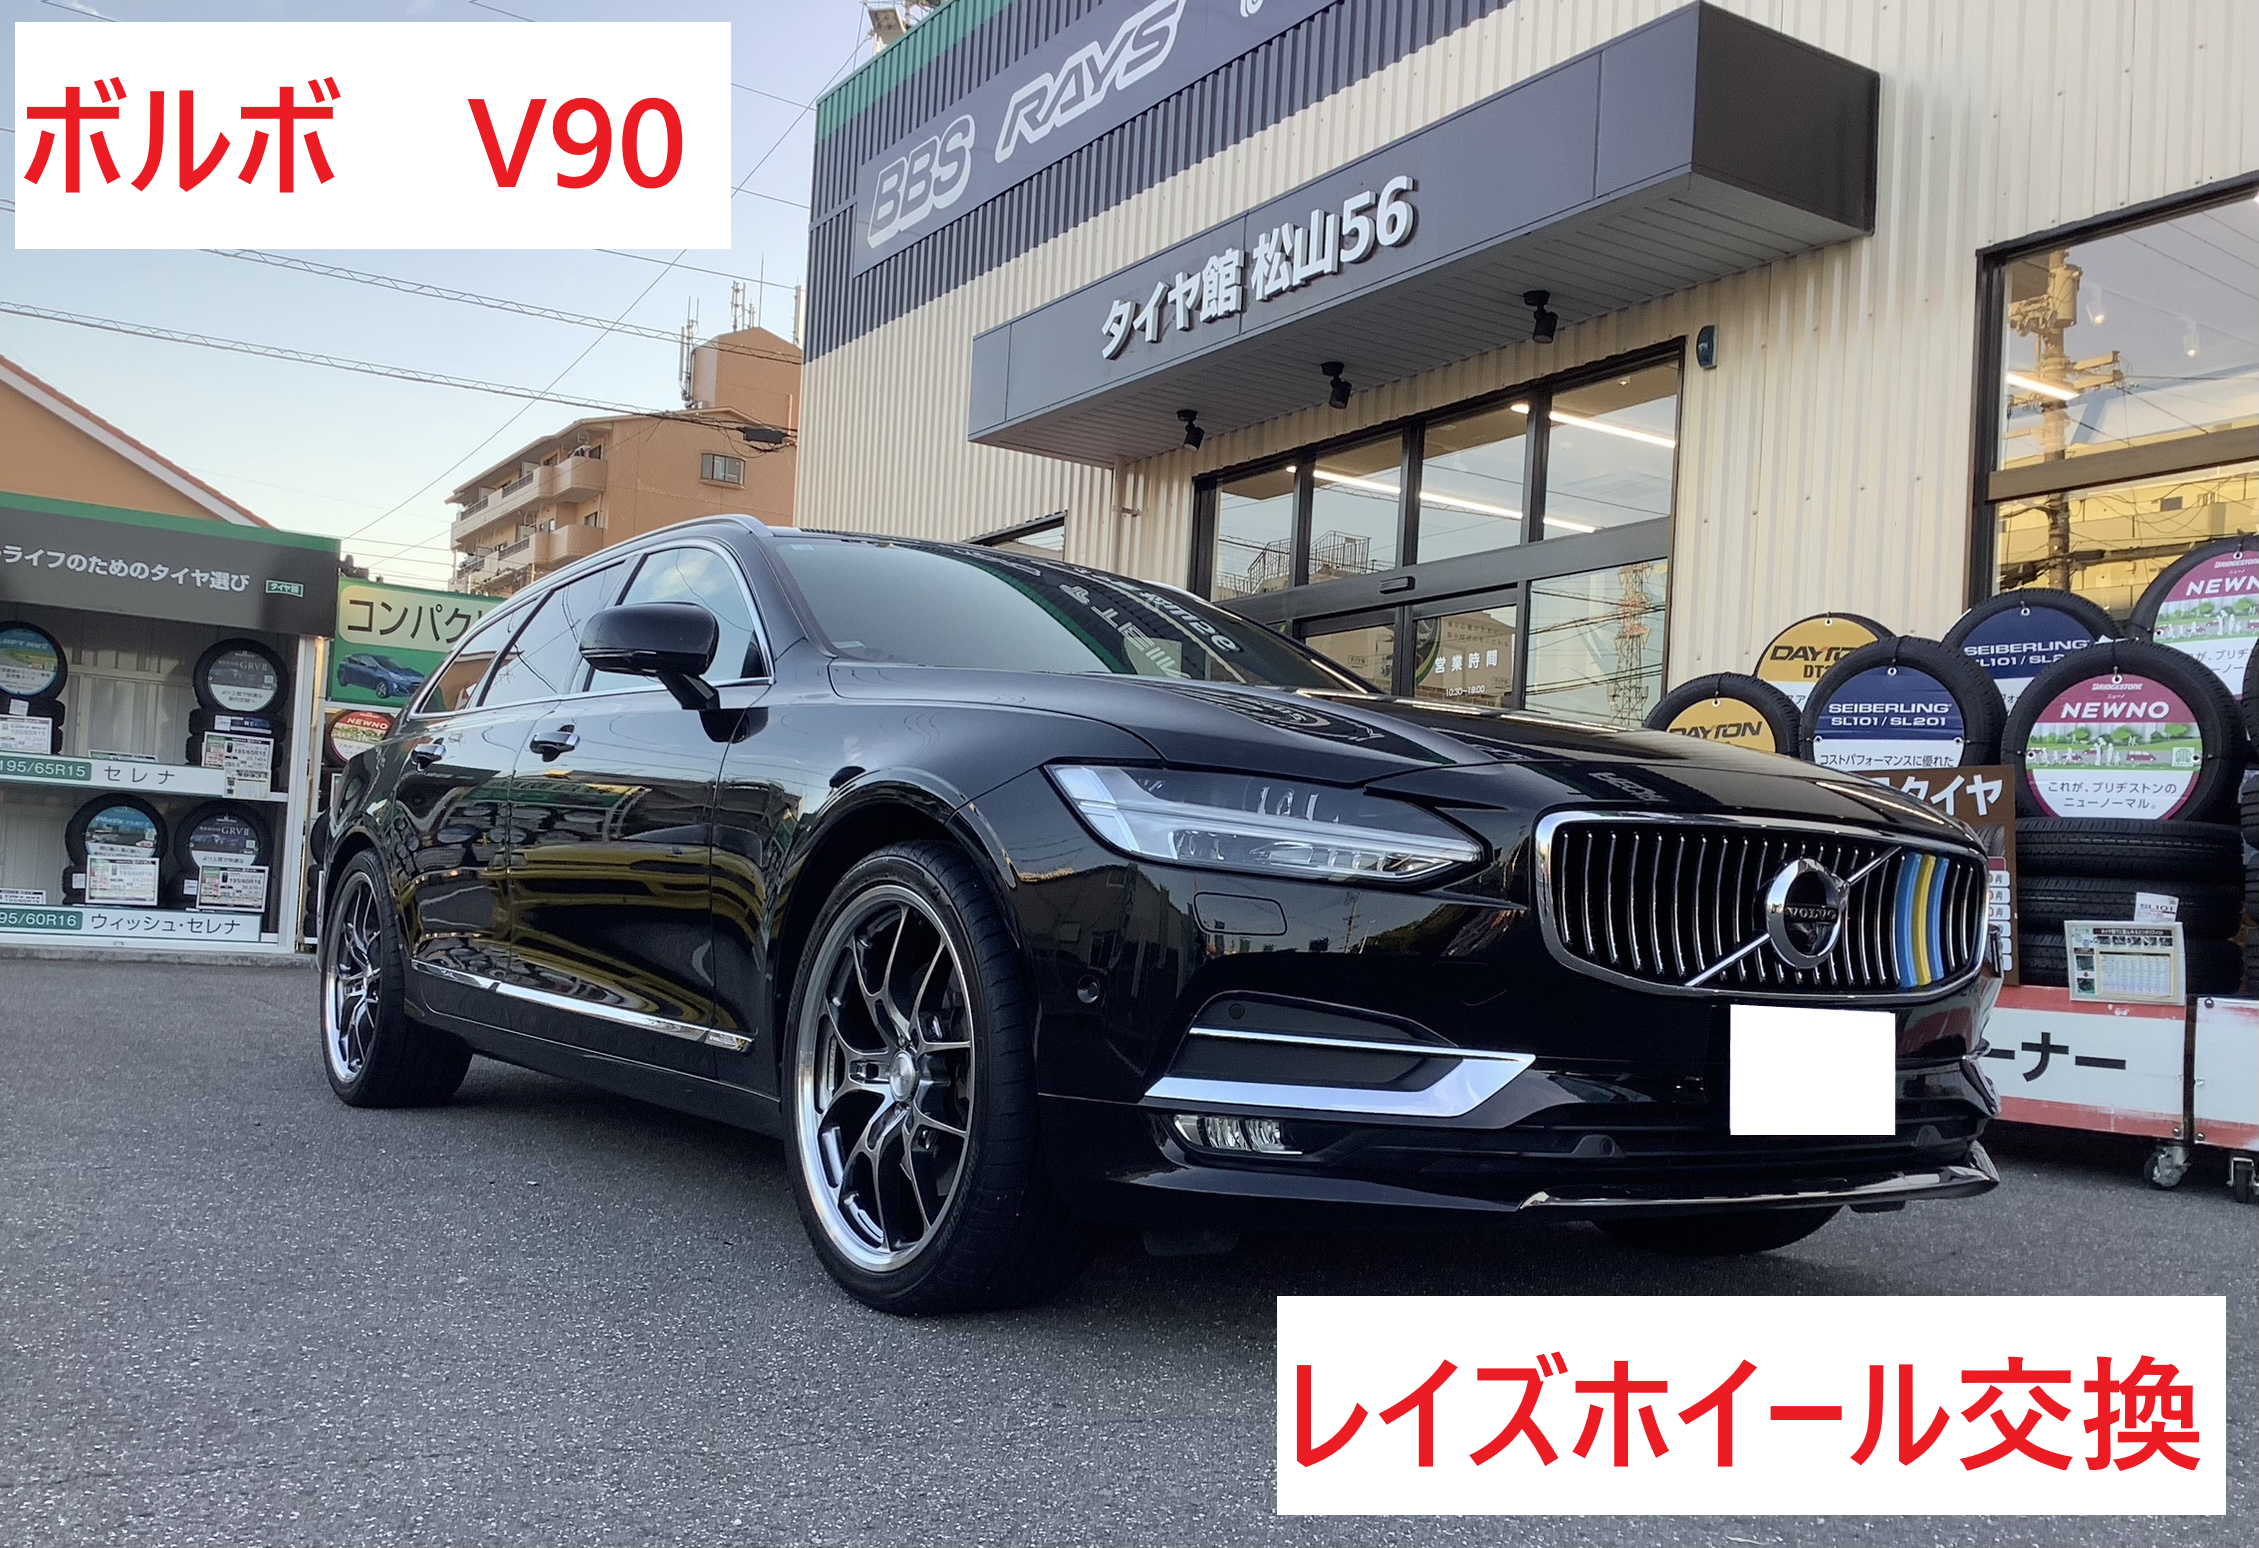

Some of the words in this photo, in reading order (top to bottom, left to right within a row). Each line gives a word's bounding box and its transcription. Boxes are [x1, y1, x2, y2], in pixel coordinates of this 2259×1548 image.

[867, 114, 976, 248] BBS
[995, 0, 1186, 163] RAYS
[1101, 248, 1245, 360] タイヤ館
[1251, 175, 1414, 302] 松山56
[0, 544, 250, 592] ライフのためのタイヤ選び
[347, 599, 482, 644] コンパク
[1964, 639, 2090, 656] SEIBERLING
[1434, 649, 1499, 674] 営業時間
[1976, 656, 2018, 668] L101
[2092, 682, 2144, 691] BRIDGESTONE
[1829, 703, 1950, 715] SEIBERLING
[2061, 701, 2170, 719] NEWNO
[346, 717, 389, 730] NEWNO
[1831, 717, 1879, 727] SL101
[1890, 717, 1946, 727] SL201
[0, 759, 86, 778] 195/65R15
[1820, 753, 1954, 768] コストパフォーマンスに優れた
[104, 765, 175, 785] セレナ
[1870, 773, 2004, 817] タイヤ
[2048, 781, 2177, 794] これが、ブリヂストンの
[2064, 797, 2157, 810] ニューノーマル。
[0, 911, 77, 928] 95/60R16
[1786, 907, 1837, 920] VOLVO
[91, 913, 241, 935] ウィッシュ・セレナ
